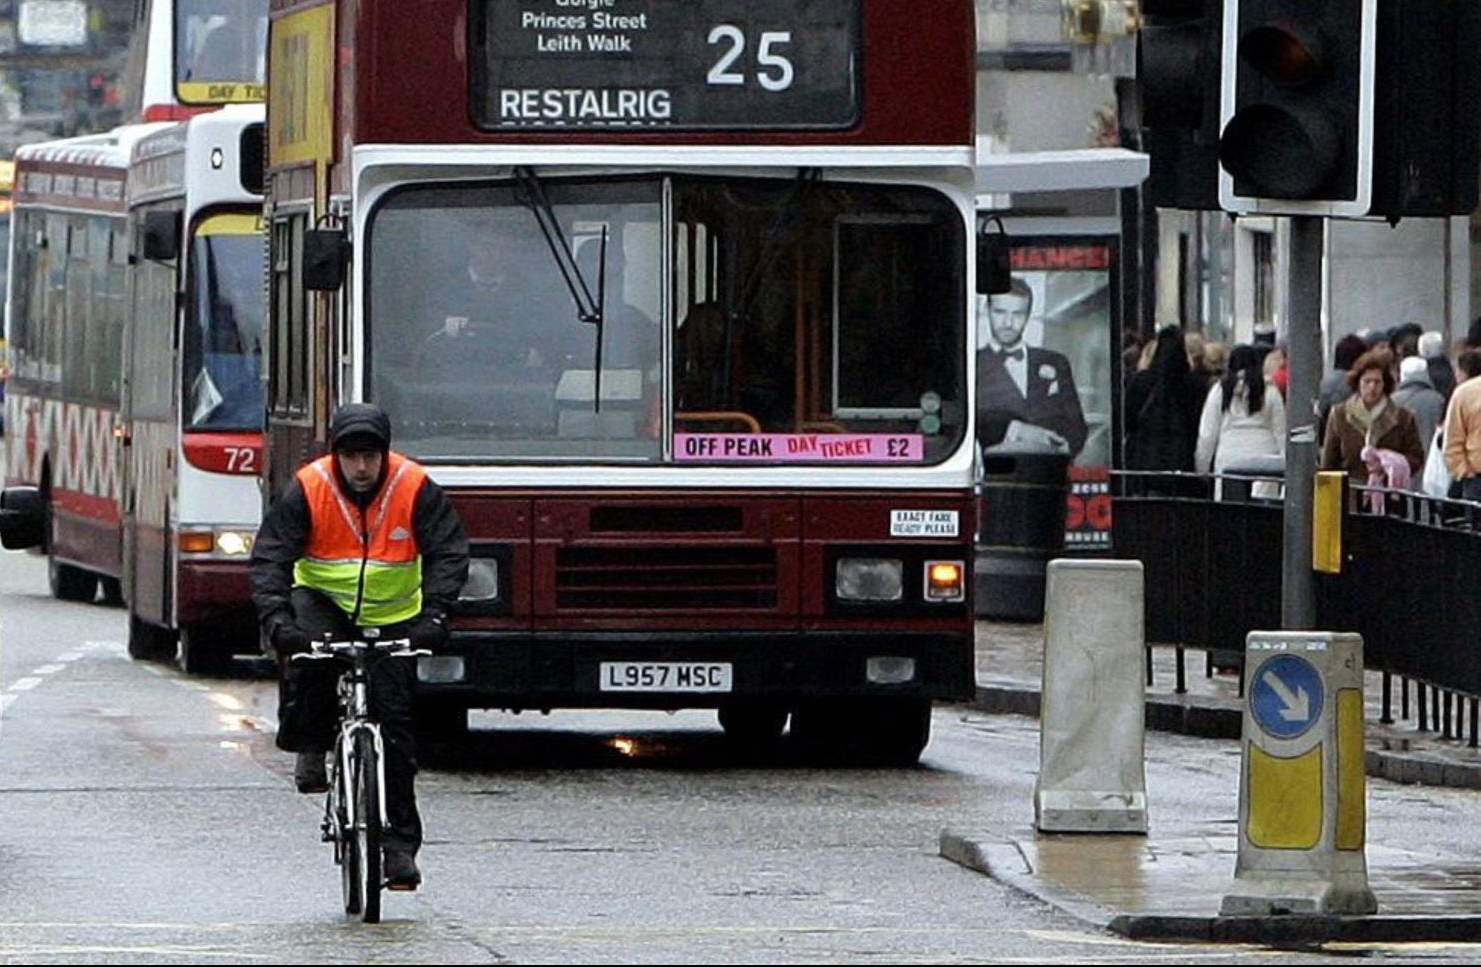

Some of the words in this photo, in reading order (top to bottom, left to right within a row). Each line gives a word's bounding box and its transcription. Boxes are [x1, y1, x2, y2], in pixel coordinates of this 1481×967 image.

[523, 12, 586, 29] Princes
[593, 12, 645, 29] Street
[538, 35, 580, 52] Leith
[587, 35, 631, 52] Walk
[706, 26, 793, 90] 25
[501, 90, 671, 117] RESTALRIG
[686, 438, 717, 456] OFF
[725, 438, 772, 456] PEAK
[788, 436, 818, 453] DAY
[820, 439, 872, 458] TICKET
[887, 439, 909, 456] £2
[224, 448, 254, 471] 72
[896, 512, 925, 521] EXACT
[610, 666, 669, 686] L957
[677, 666, 721, 687] MSC
